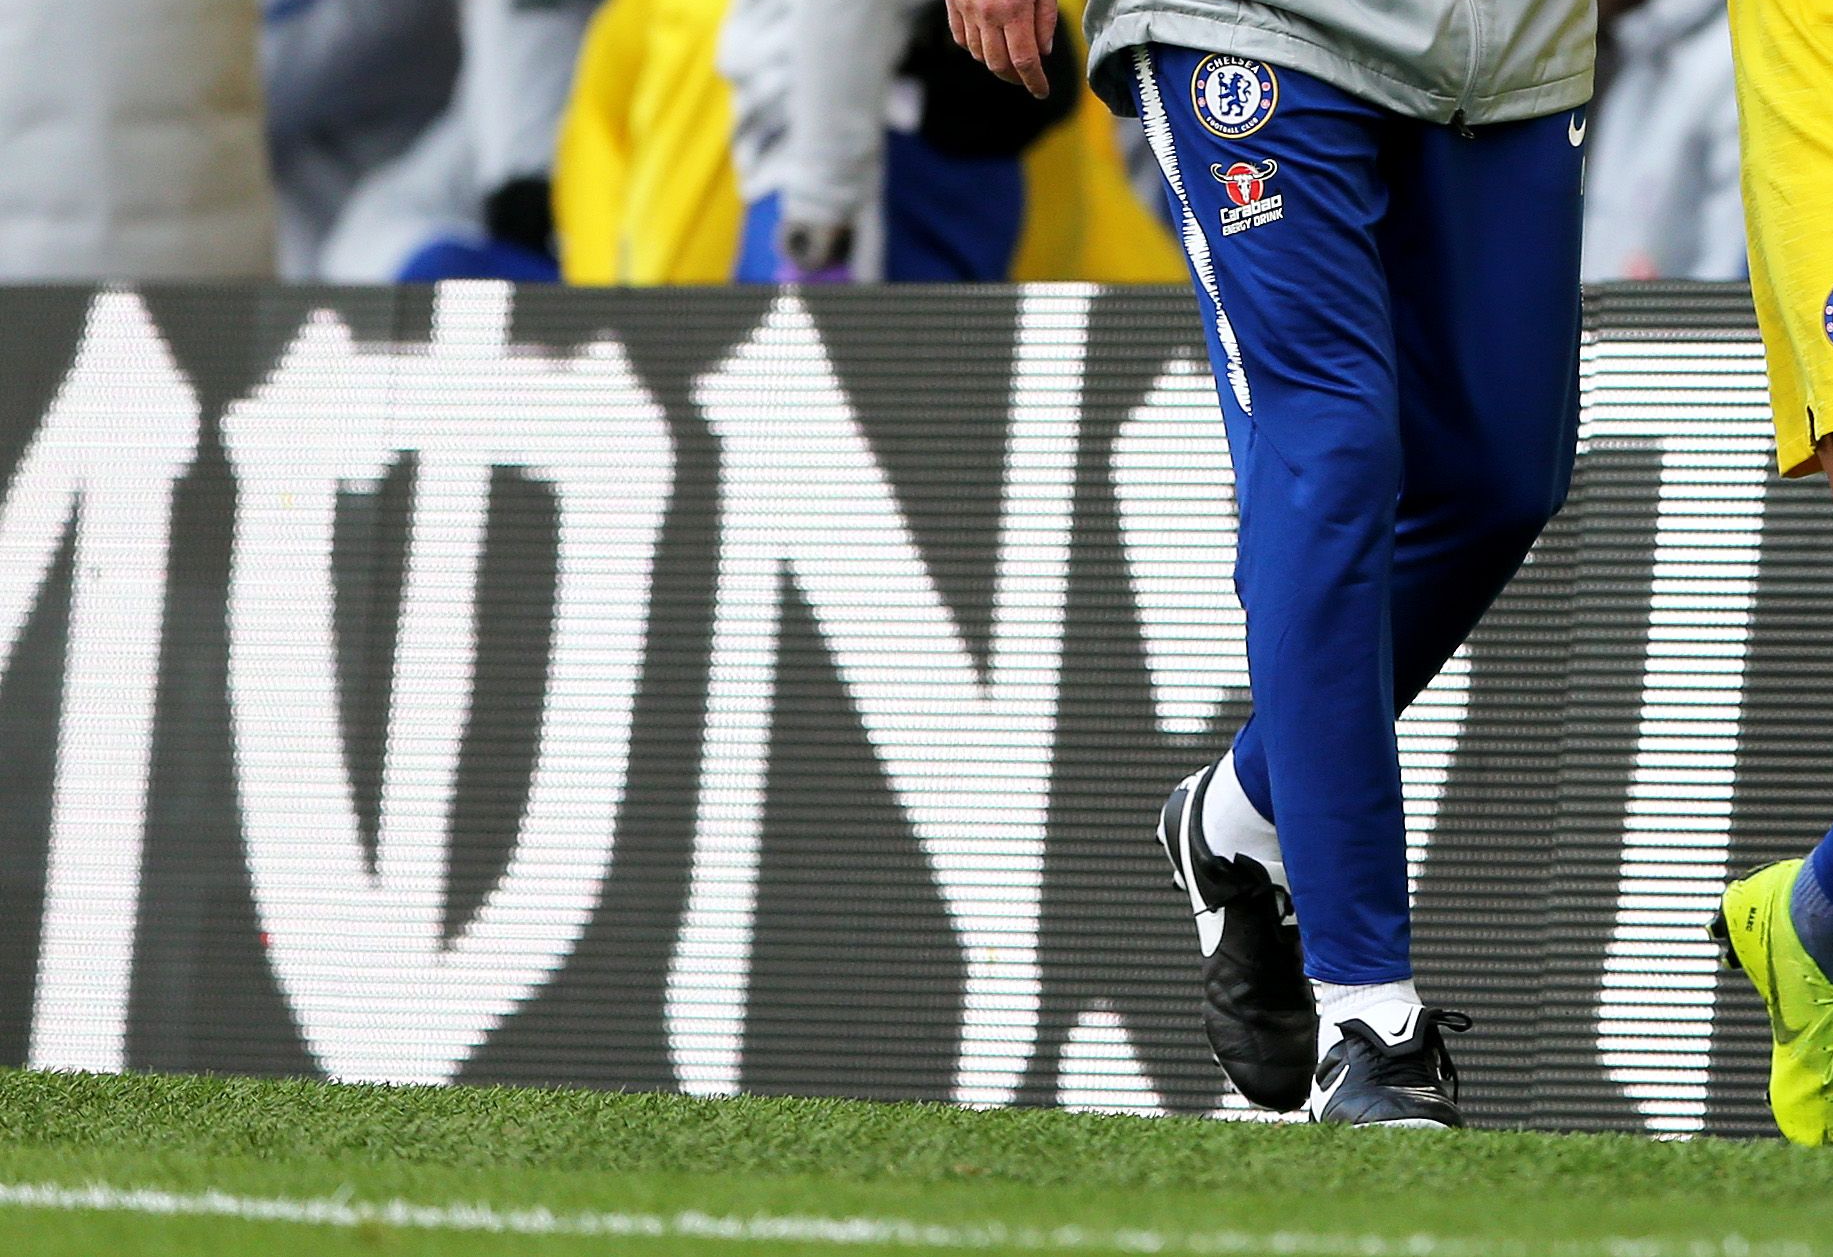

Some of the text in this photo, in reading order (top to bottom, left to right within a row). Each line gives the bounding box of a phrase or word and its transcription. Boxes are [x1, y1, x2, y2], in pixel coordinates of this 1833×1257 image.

[1206, 56, 1260, 75] CHELSEA
[1205, 116, 1259, 134] FOOTBALL CLUB
[1219, 195, 1283, 224] Carabao
[1222, 208, 1284, 236] ENERGY DRINK
